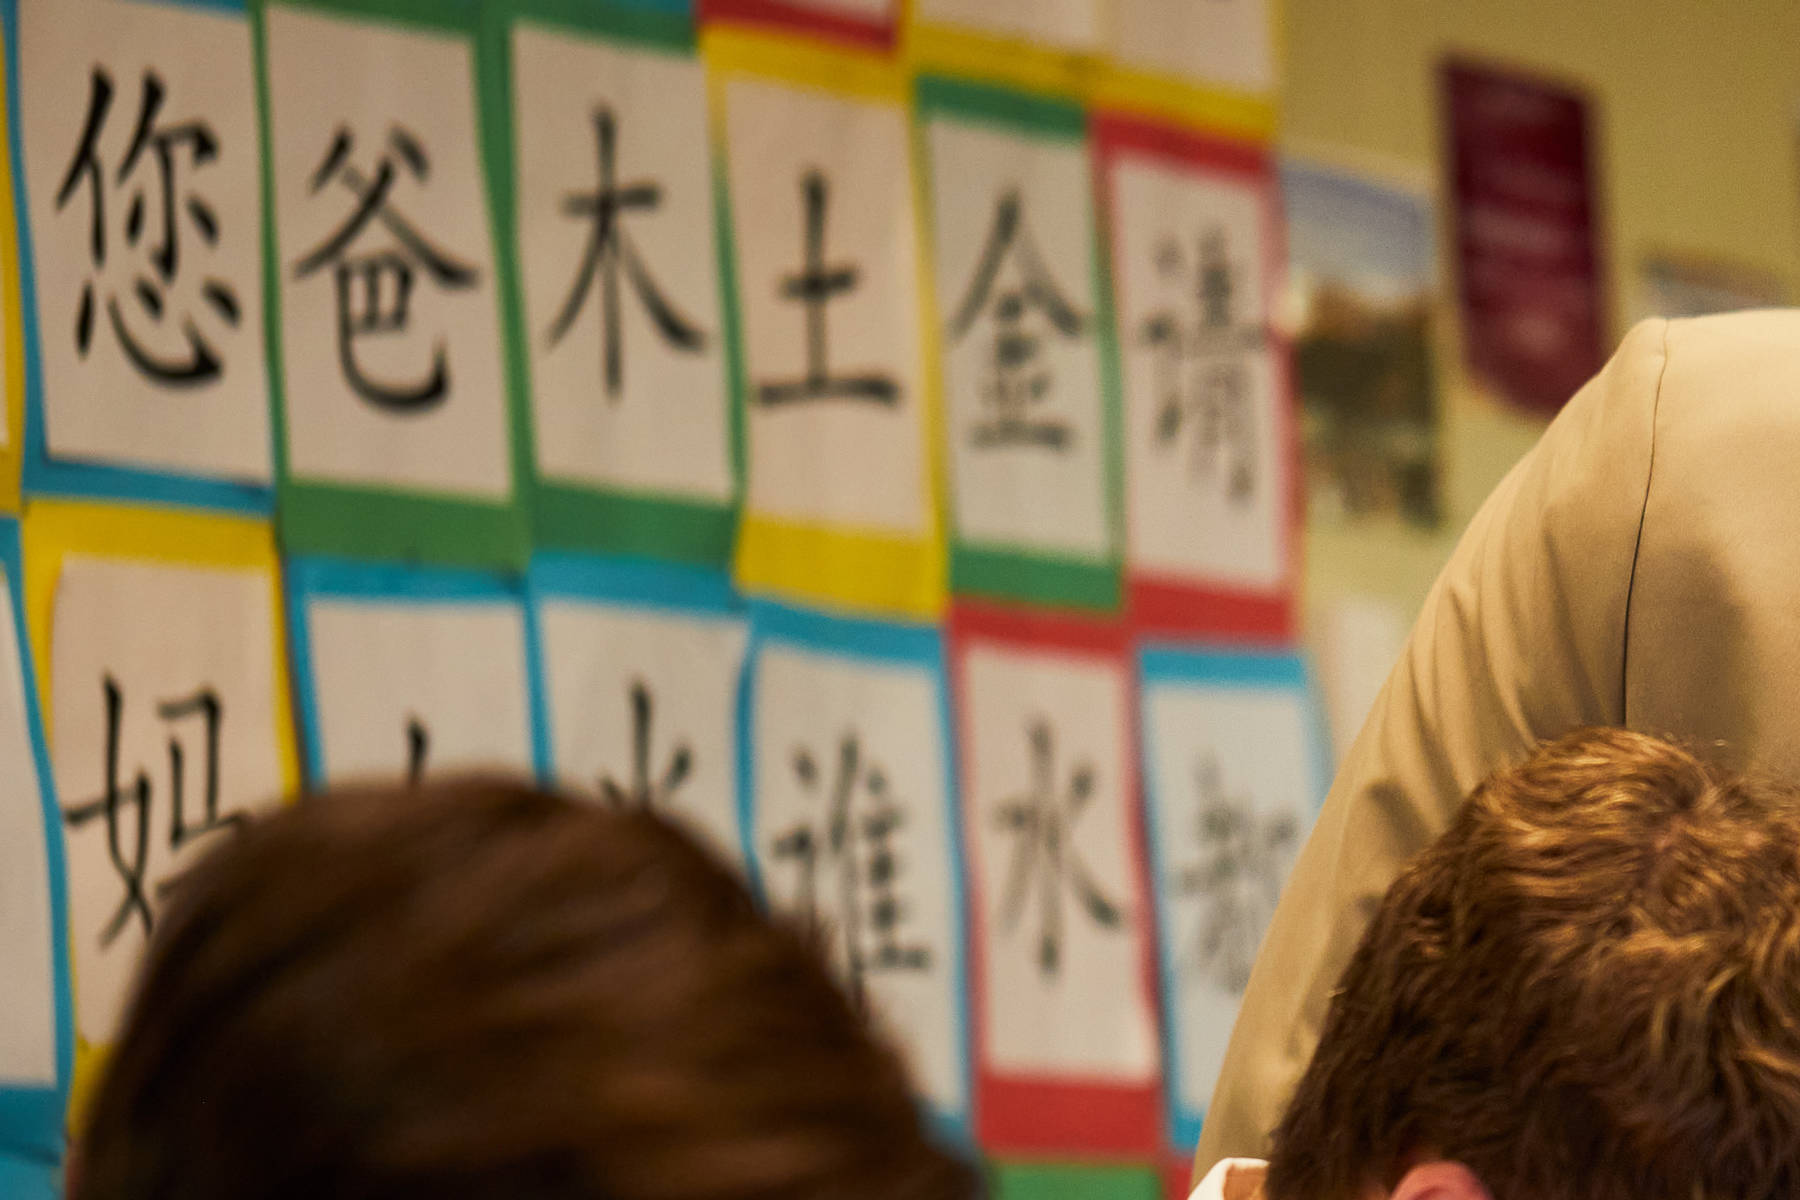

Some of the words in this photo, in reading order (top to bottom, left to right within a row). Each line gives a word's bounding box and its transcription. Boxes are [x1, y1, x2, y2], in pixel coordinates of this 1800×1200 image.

[55, 63, 241, 389] 您
[293, 124, 481, 415] 爸
[545, 98, 709, 403] 木
[753, 169, 903, 406] 土
[947, 186, 1088, 450] 金
[996, 715, 1125, 985] 水
